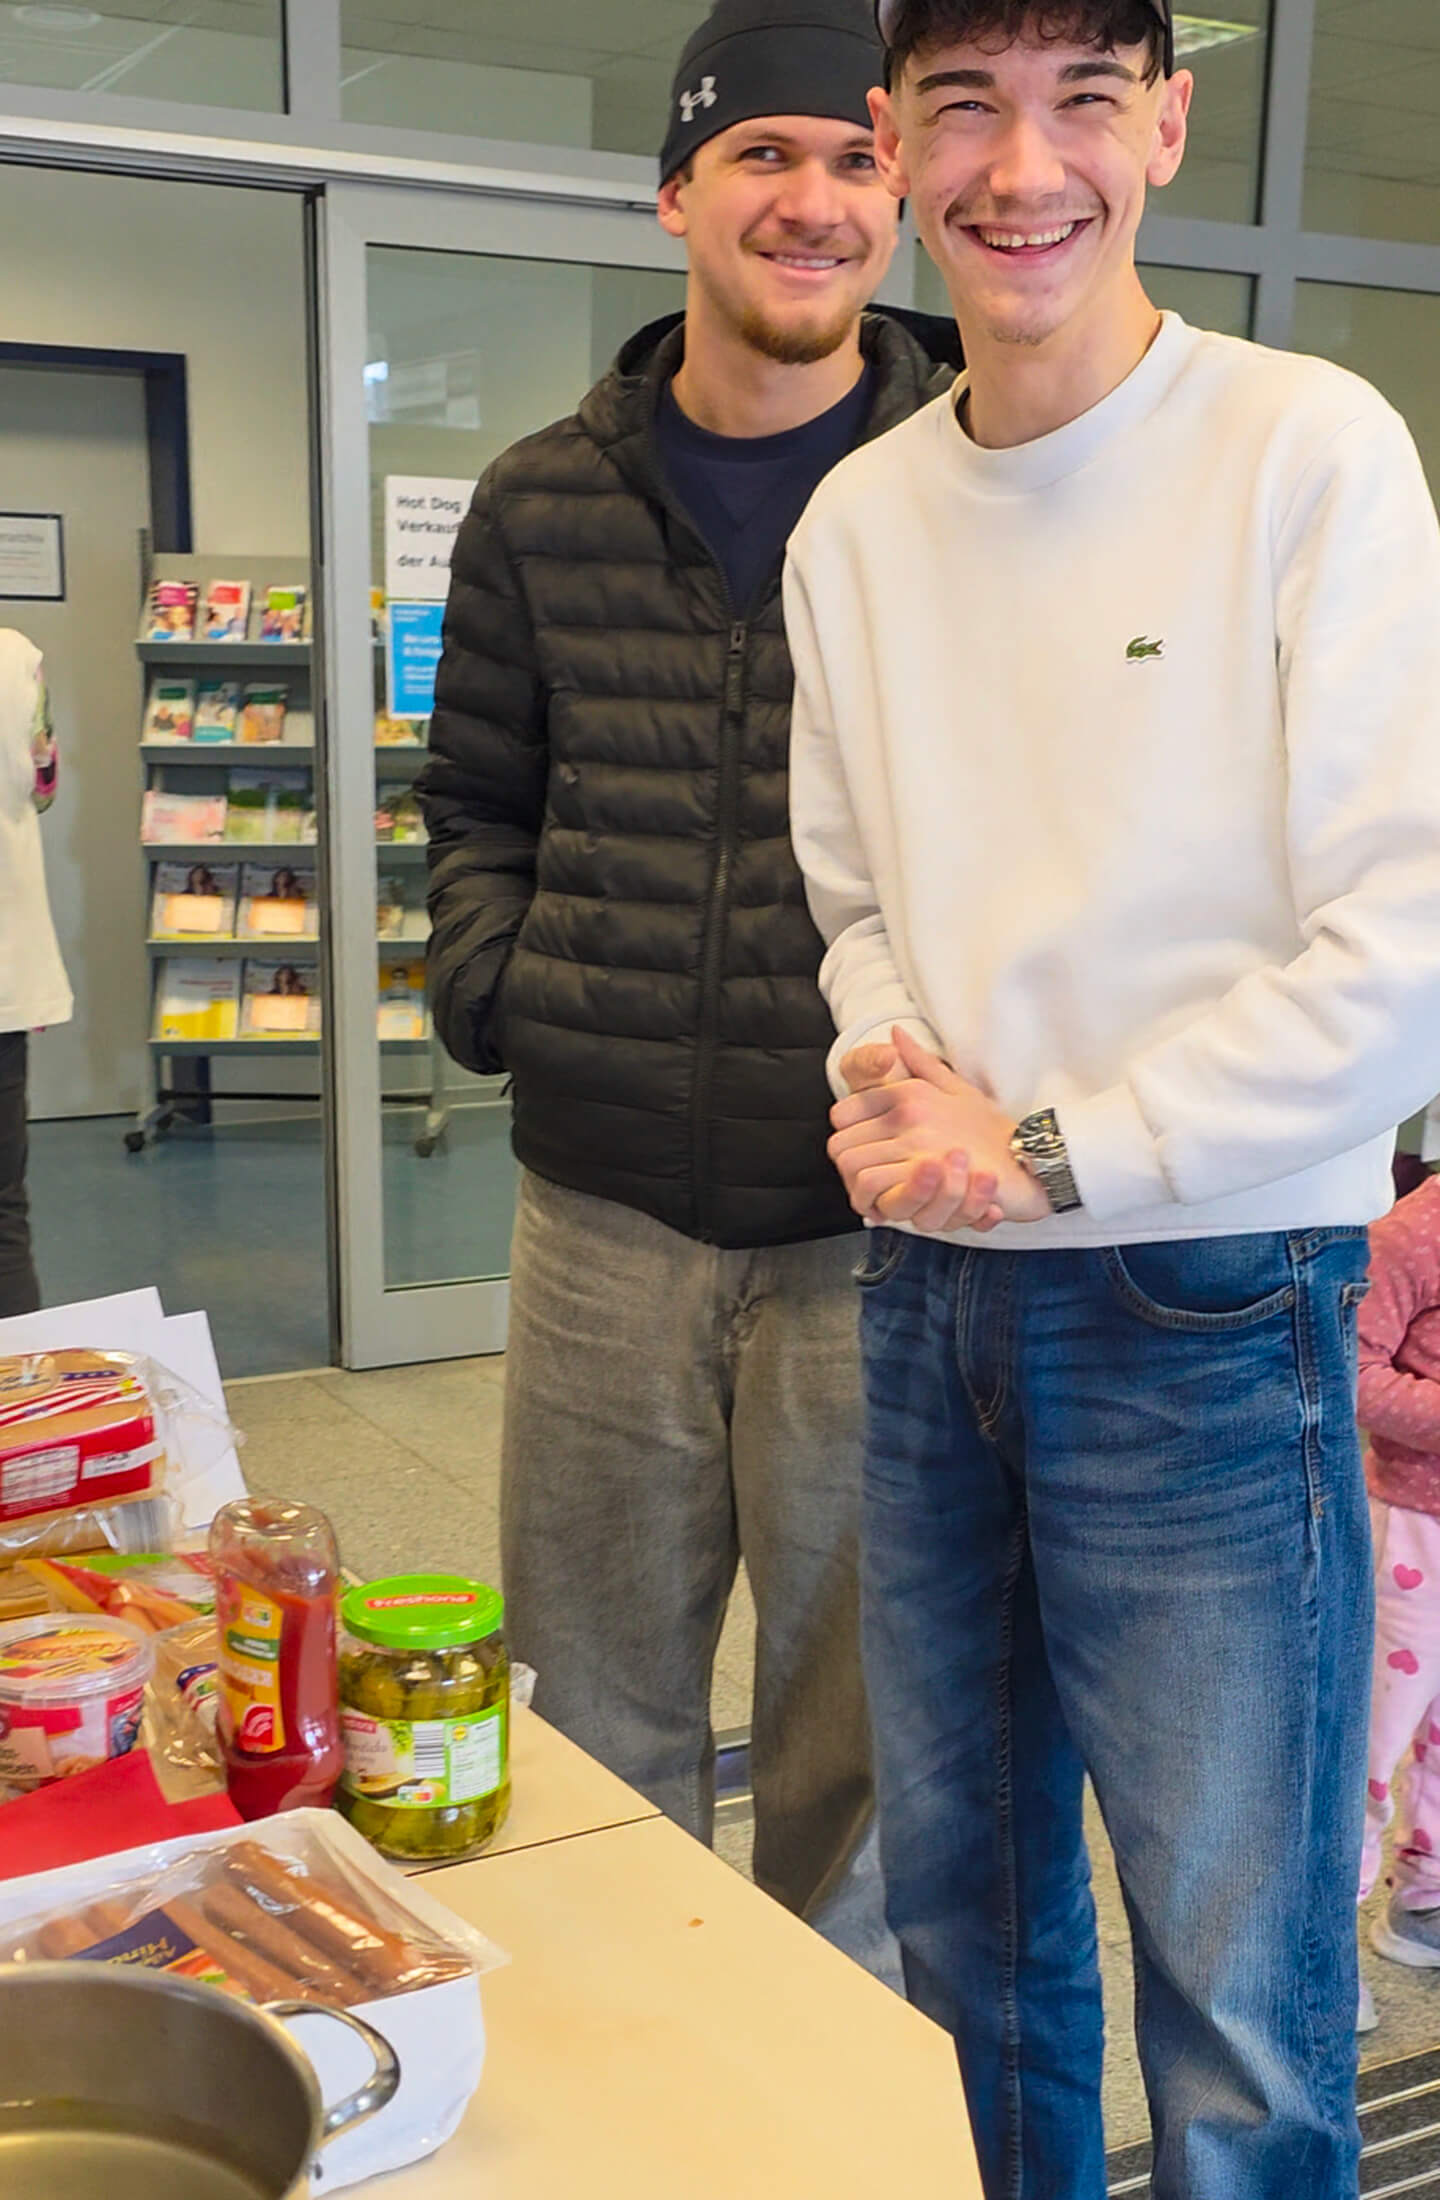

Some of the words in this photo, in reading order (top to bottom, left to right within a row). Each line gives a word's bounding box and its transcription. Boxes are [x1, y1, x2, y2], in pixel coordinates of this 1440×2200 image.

[397, 496, 426, 509] Hot
[431, 497, 461, 514] Dog
[398, 554, 424, 567] der
